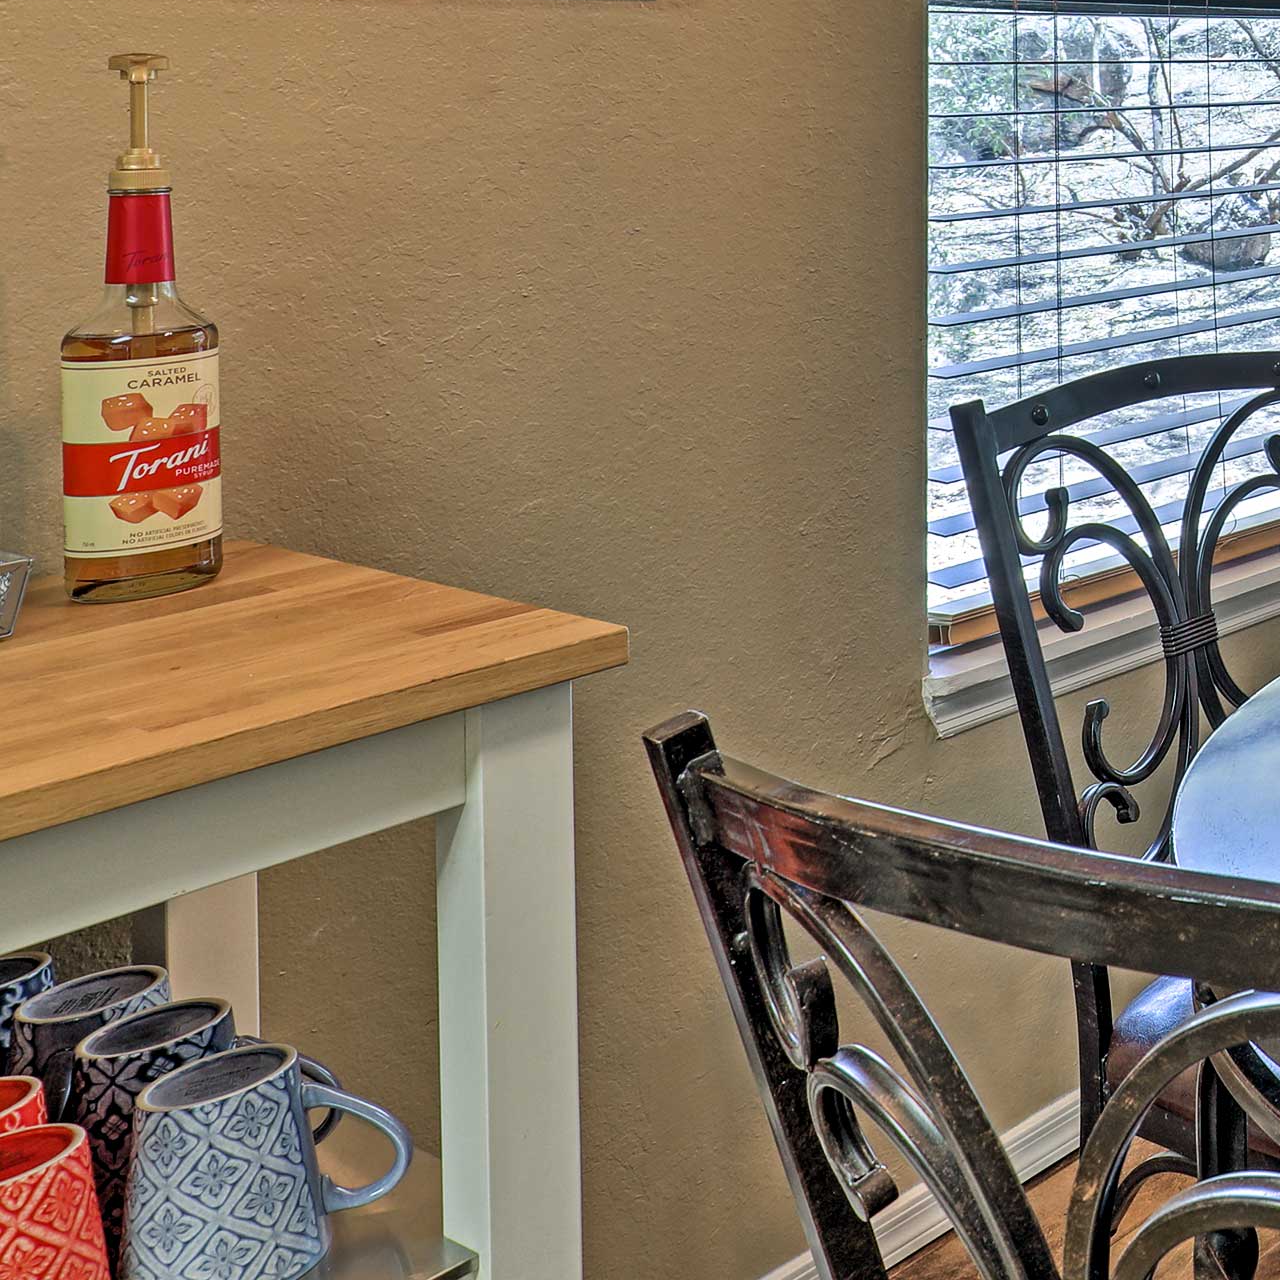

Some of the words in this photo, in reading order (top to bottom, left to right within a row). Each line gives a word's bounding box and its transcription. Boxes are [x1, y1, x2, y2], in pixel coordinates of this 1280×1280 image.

[127, 372, 201, 390] CARAMEL
[147, 367, 186, 377] SALTED
[109, 433, 209, 491] Torani
